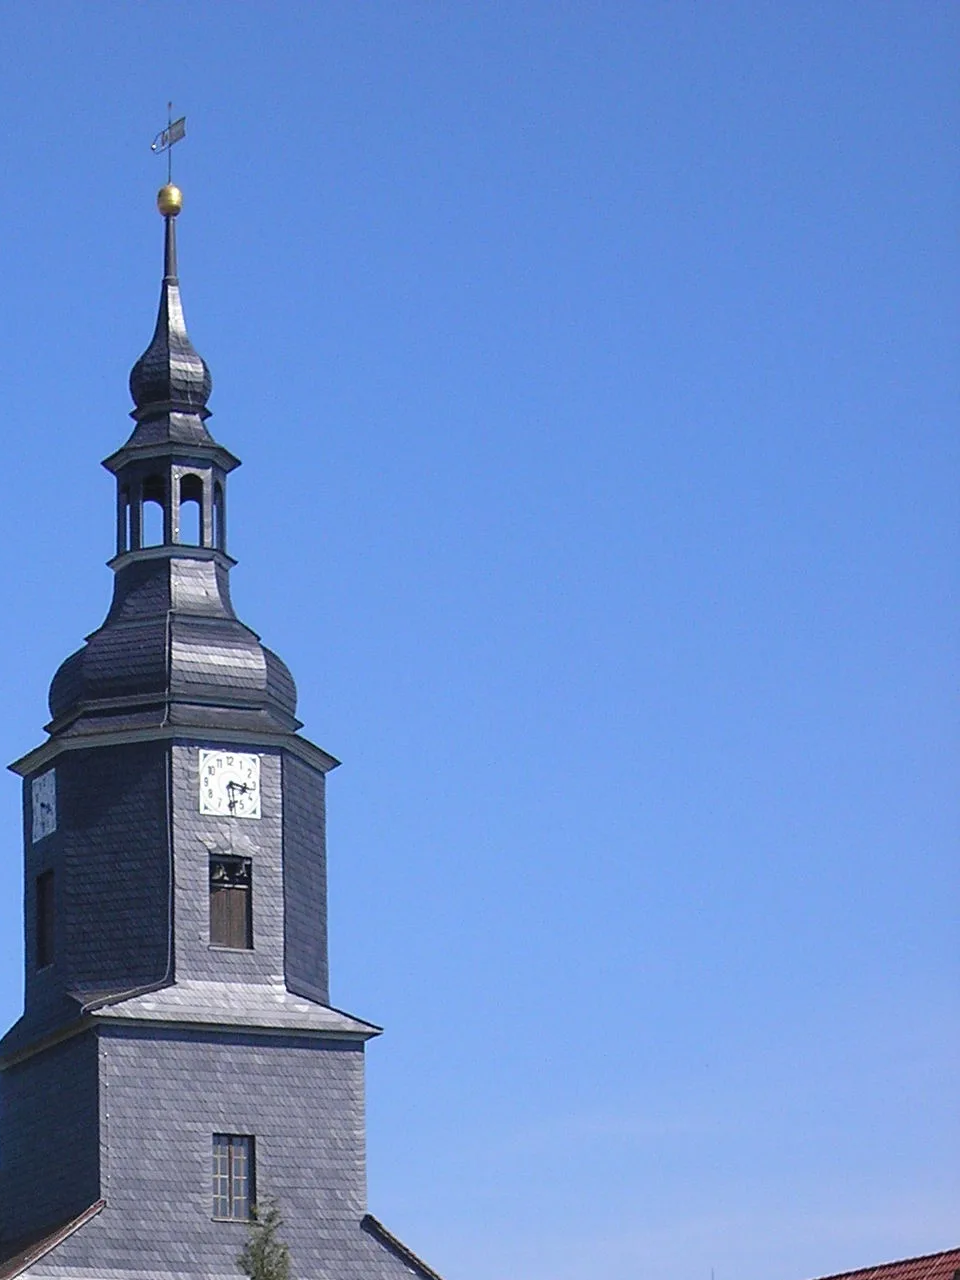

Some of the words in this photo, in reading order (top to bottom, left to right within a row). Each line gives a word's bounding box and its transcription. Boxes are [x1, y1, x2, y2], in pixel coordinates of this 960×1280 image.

[216, 758, 222, 768] 11
[226, 756, 234, 766] 12
[208, 766, 215, 776] 10
